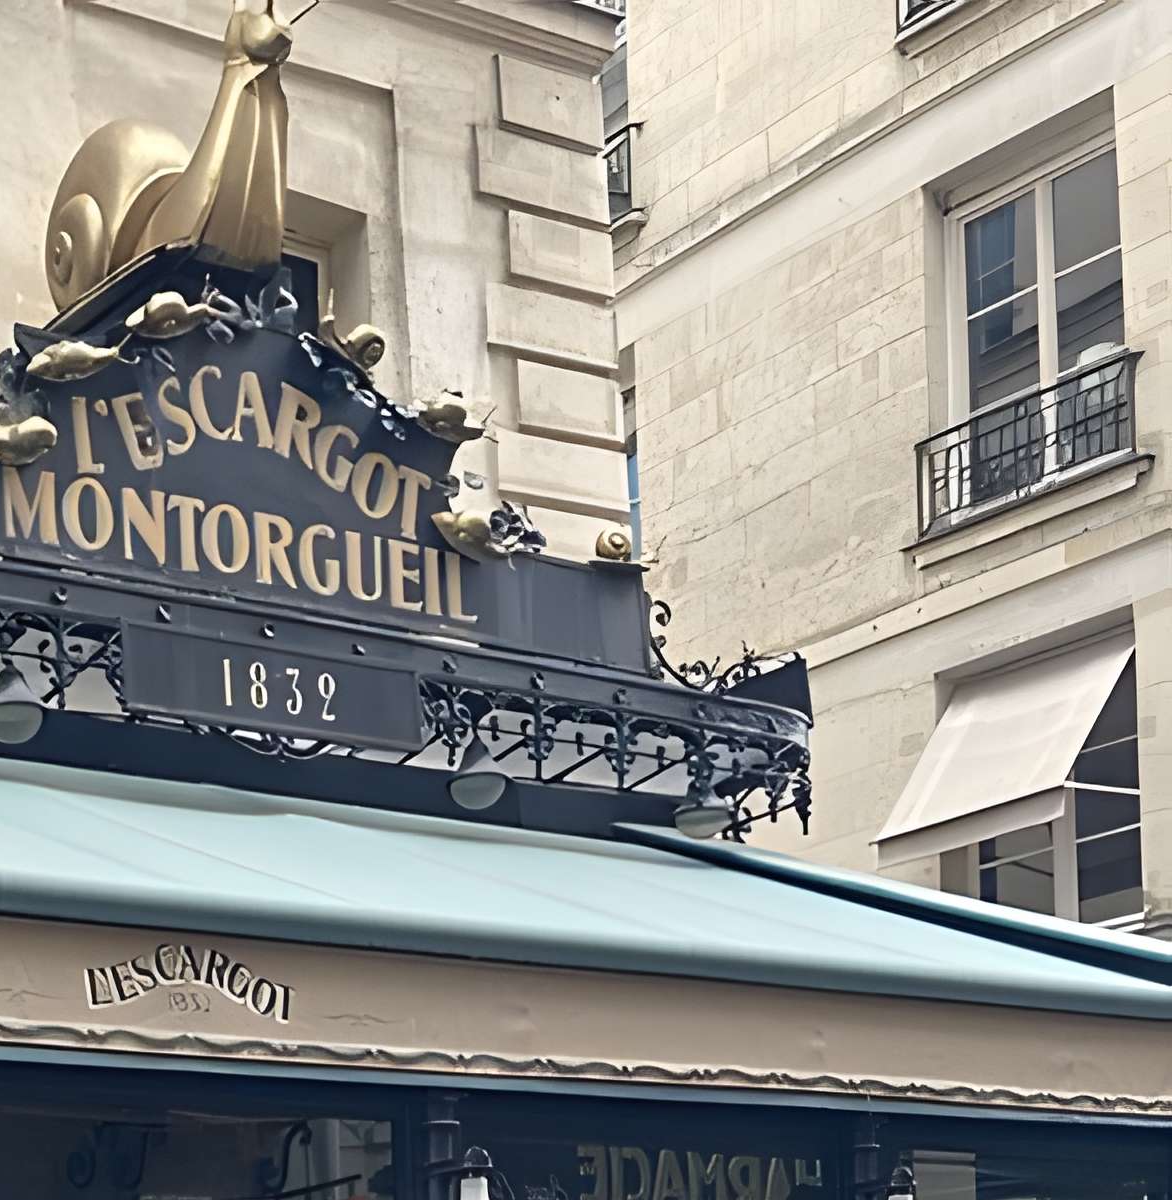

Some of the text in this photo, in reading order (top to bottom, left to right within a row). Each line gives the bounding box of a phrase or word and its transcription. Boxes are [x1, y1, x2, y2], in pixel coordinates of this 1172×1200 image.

[71, 366, 431, 539] L'ESCARGOT
[2, 469, 478, 622] MONTORGUEIL
[222, 658, 336, 721] 1832
